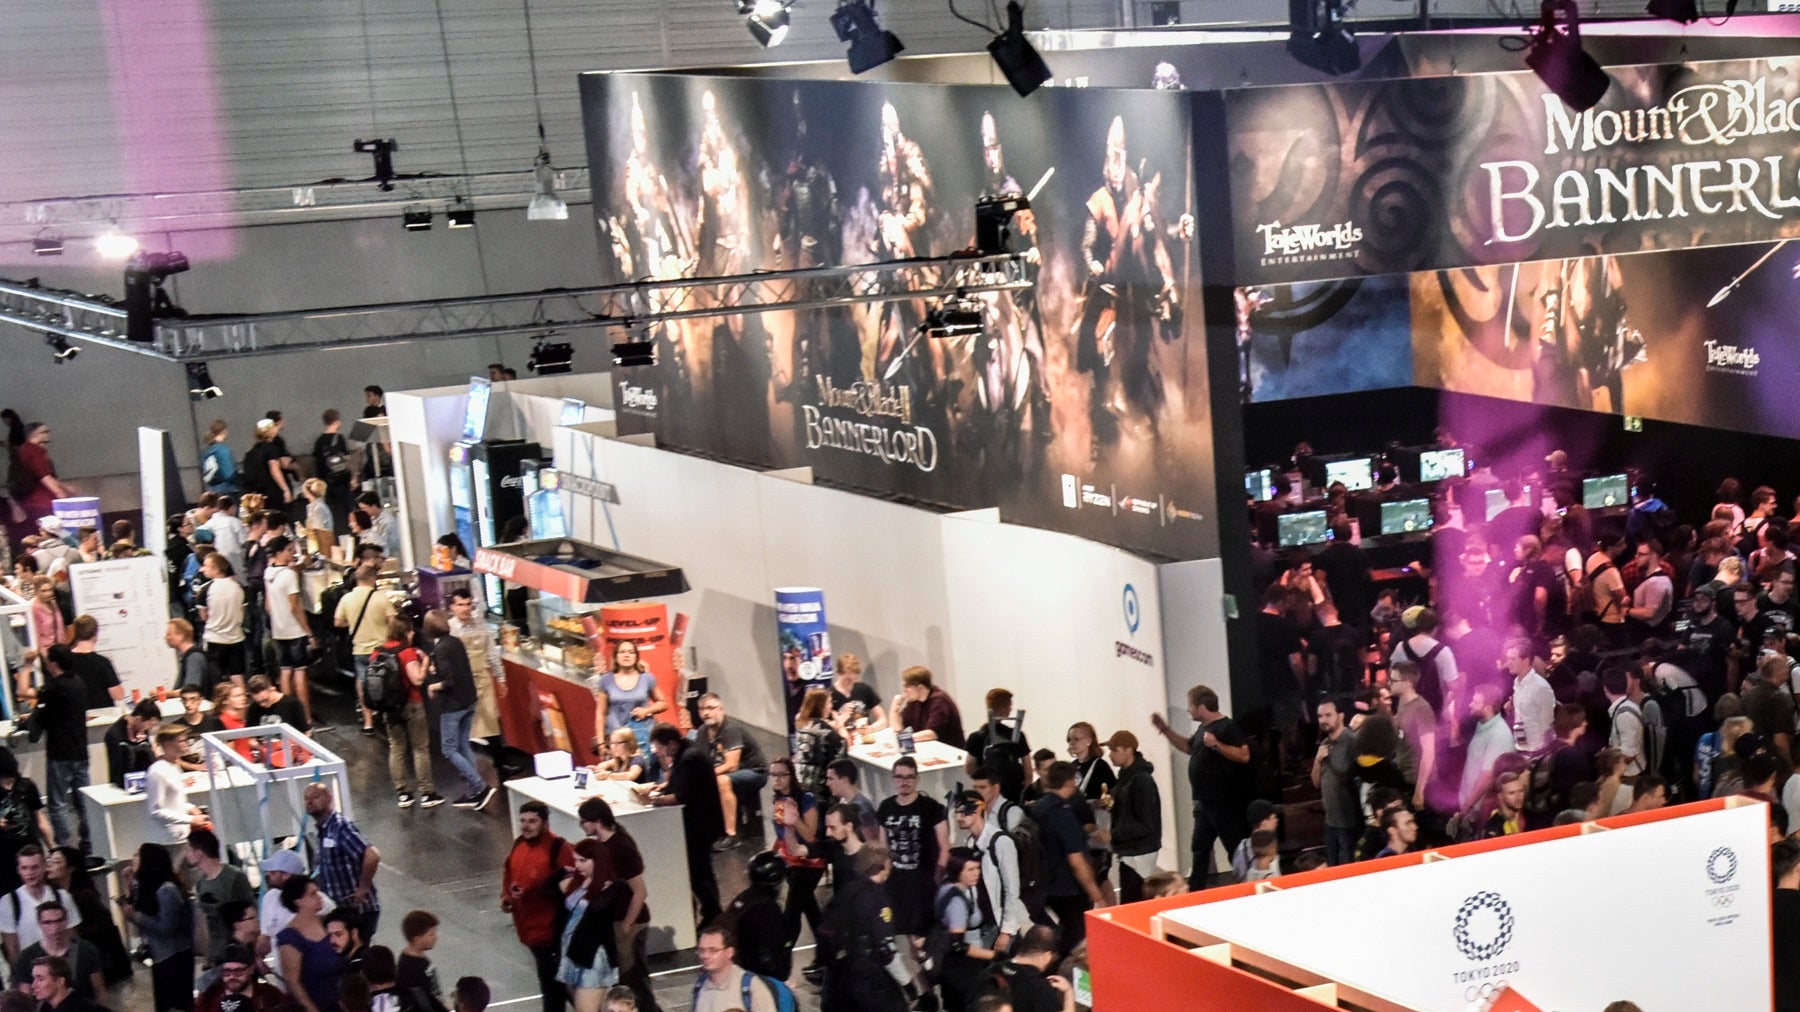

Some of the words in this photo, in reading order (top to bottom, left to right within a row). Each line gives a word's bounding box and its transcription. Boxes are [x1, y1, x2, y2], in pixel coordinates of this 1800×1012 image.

[1255, 220, 1363, 255] TaleWorlds
[1260, 249, 1361, 267] ENTERTAINMENT
[801, 404, 938, 473] BANNERLORD
[605, 616, 661, 628] LEVEL-UP
[1115, 641, 1154, 667] gamescom
[1453, 966, 1491, 984] TOKYO
[1492, 960, 1520, 977] 2020
